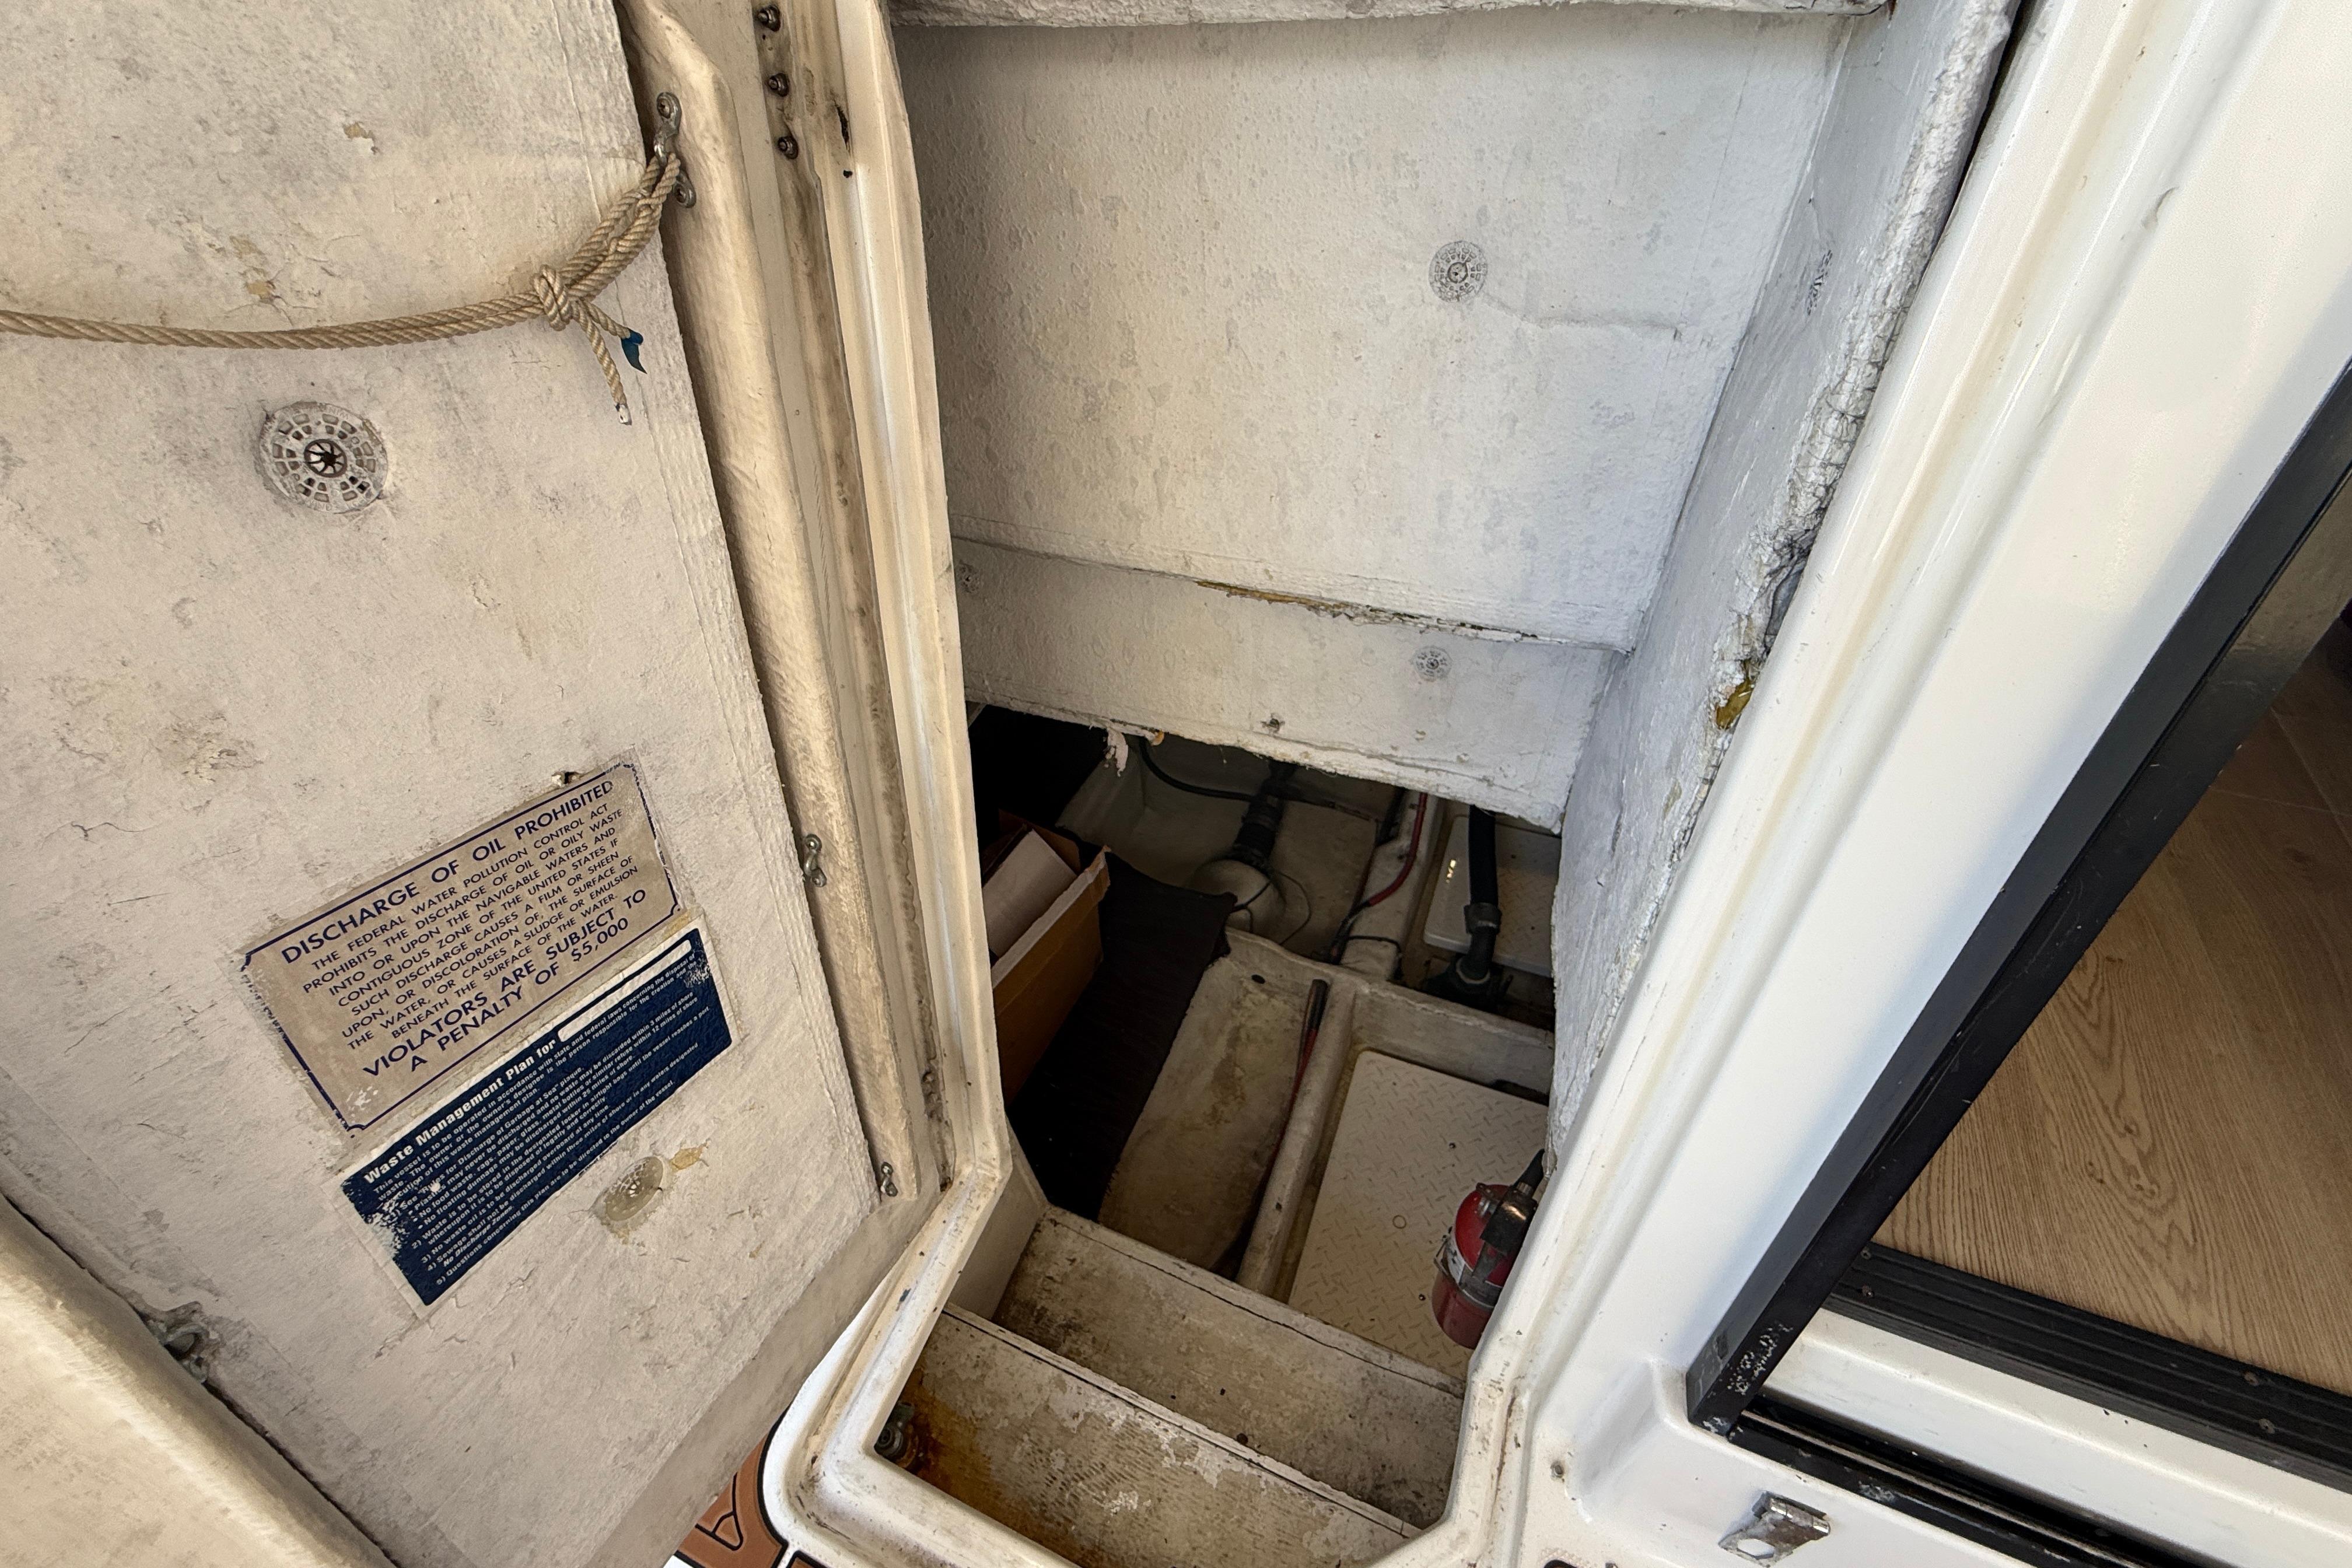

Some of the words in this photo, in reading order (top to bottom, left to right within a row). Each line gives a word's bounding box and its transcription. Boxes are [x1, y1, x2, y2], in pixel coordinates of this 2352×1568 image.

[281, 881, 420, 964] DISCHARGE
[430, 859, 459, 883] OF
[472, 838, 506, 861] OIL
[513, 780, 613, 840] PROHIBITED
[302, 947, 377, 993] PROHIBITS
[382, 928, 409, 947] THE
[415, 885, 487, 930] DISCHARGE
[492, 872, 508, 886] OF
[514, 859, 534, 874] OIL
[538, 846, 556, 860] OR
[561, 830, 583, 848] OILY
[589, 808, 622, 832] WASTE
[311, 950, 341, 970] THE
[346, 915, 406, 951] FEDERAL
[411, 886, 457, 915] WATER
[463, 847, 528, 888] POLLUTION
[533, 817, 584, 849] CONTROL
[590, 802, 607, 820] ACT
[328, 971, 366, 996] INTO
[372, 954, 394, 970] OR
[400, 926, 440, 954] UPON
[446, 909, 470, 928] THE
[475, 869, 541, 911] NAVIGABLE
[545, 842, 588, 870] WATERS
[594, 827, 615, 845] AND
[338, 948, 430, 1007] CONTIGUOUS
[436, 923, 473, 950] ZONE
[478, 909, 495, 924] OF
[501, 894, 523, 911] THE
[527, 869, 566, 895] UNITED
[571, 845, 606, 870] STATES
[610, 837, 618, 848] IF
[341, 1007, 388, 1038] UPON,
[395, 989, 416, 1005] OR
[421, 925, 519, 989] DISCOLORATION
[524, 911, 544, 926] OF,
[548, 894, 568, 911] THE
[573, 866, 615, 897] SURFACE
[620, 855, 632, 867] OF
[347, 1030, 374, 1049] THE
[379, 997, 430, 1029] WATER,
[436, 979, 456, 994] OR
[461, 947, 507, 978] CAUSES
[513, 939, 522, 948] A
[523, 911, 564, 941] SLUDGE
[569, 898, 585, 912] OR
[589, 865, 638, 900] EMULSION
[351, 988, 390, 1016] SUCH
[395, 940, 468, 989] DISCHARGE
[474, 911, 519, 942] CAUSES
[524, 903, 534, 913] A
[537, 885, 562, 904] FILM
[566, 873, 583, 886] OR
[587, 850, 619, 874] SHEEN
[362, 991, 488, 1076] VIOLATORS
[501, 959, 536, 992] ARE
[545, 907, 614, 960] SUBJECT
[622, 889, 646, 909] TO
[391, 998, 449, 1039] BENEATH
[453, 979, 477, 998] THE
[482, 944, 532, 981] SURFACE
[537, 932, 551, 946] OF
[556, 916, 576, 933] THE
[580, 893, 618, 918] WATER.
[411, 1055, 428, 1072] A
[436, 985, 522, 1051] PENALTY
[534, 961, 559, 985] OF
[570, 917, 628, 962] $5,000
[363, 1144, 414, 1184] Waste
[415, 1077, 504, 1146] Management
[505, 1056, 535, 1080] Plan
[536, 1039, 556, 1058] for
[373, 1178, 393, 1194] This
[394, 1156, 421, 1178] vessel
[422, 1149, 430, 1157] is
[431, 1142, 440, 1150] to
[441, 1133, 452, 1143] be
[453, 1106, 487, 1134] operated
[488, 1100, 496, 1108] in
[496, 1070, 537, 1101] accordance
[537, 1058, 553, 1071] with
[553, 1045, 570, 1059] state
[571, 1034, 584, 1046] and
[583, 1017, 607, 1037] federal
[622, 983, 654, 1009] concerning
[654, 976, 664, 985] the
[664, 958, 688, 978] disposal
[688, 953, 695, 961] of
[408, 1163, 426, 1177] The
[428, 1142, 453, 1163] owner
[456, 1133, 464, 1142] or
[466, 1122, 480, 1133] the
[482, 1098, 511, 1122] owner's
[513, 1073, 544, 1099] designee
[555, 1056, 566, 1066] the
[568, 1038, 590, 1058] person
[592, 1011, 628, 1040] responsible
[628, 1003, 638, 1012] for
[639, 995, 649, 1004] the
[650, 977, 674, 996] creation
[676, 967, 686, 978] and
[687, 960, 697, 970] the
[424, 1166, 433, 1176] of
[433, 1155, 450, 1168] this
[449, 1137, 473, 1156] waste
[473, 1099, 521, 1138] management
